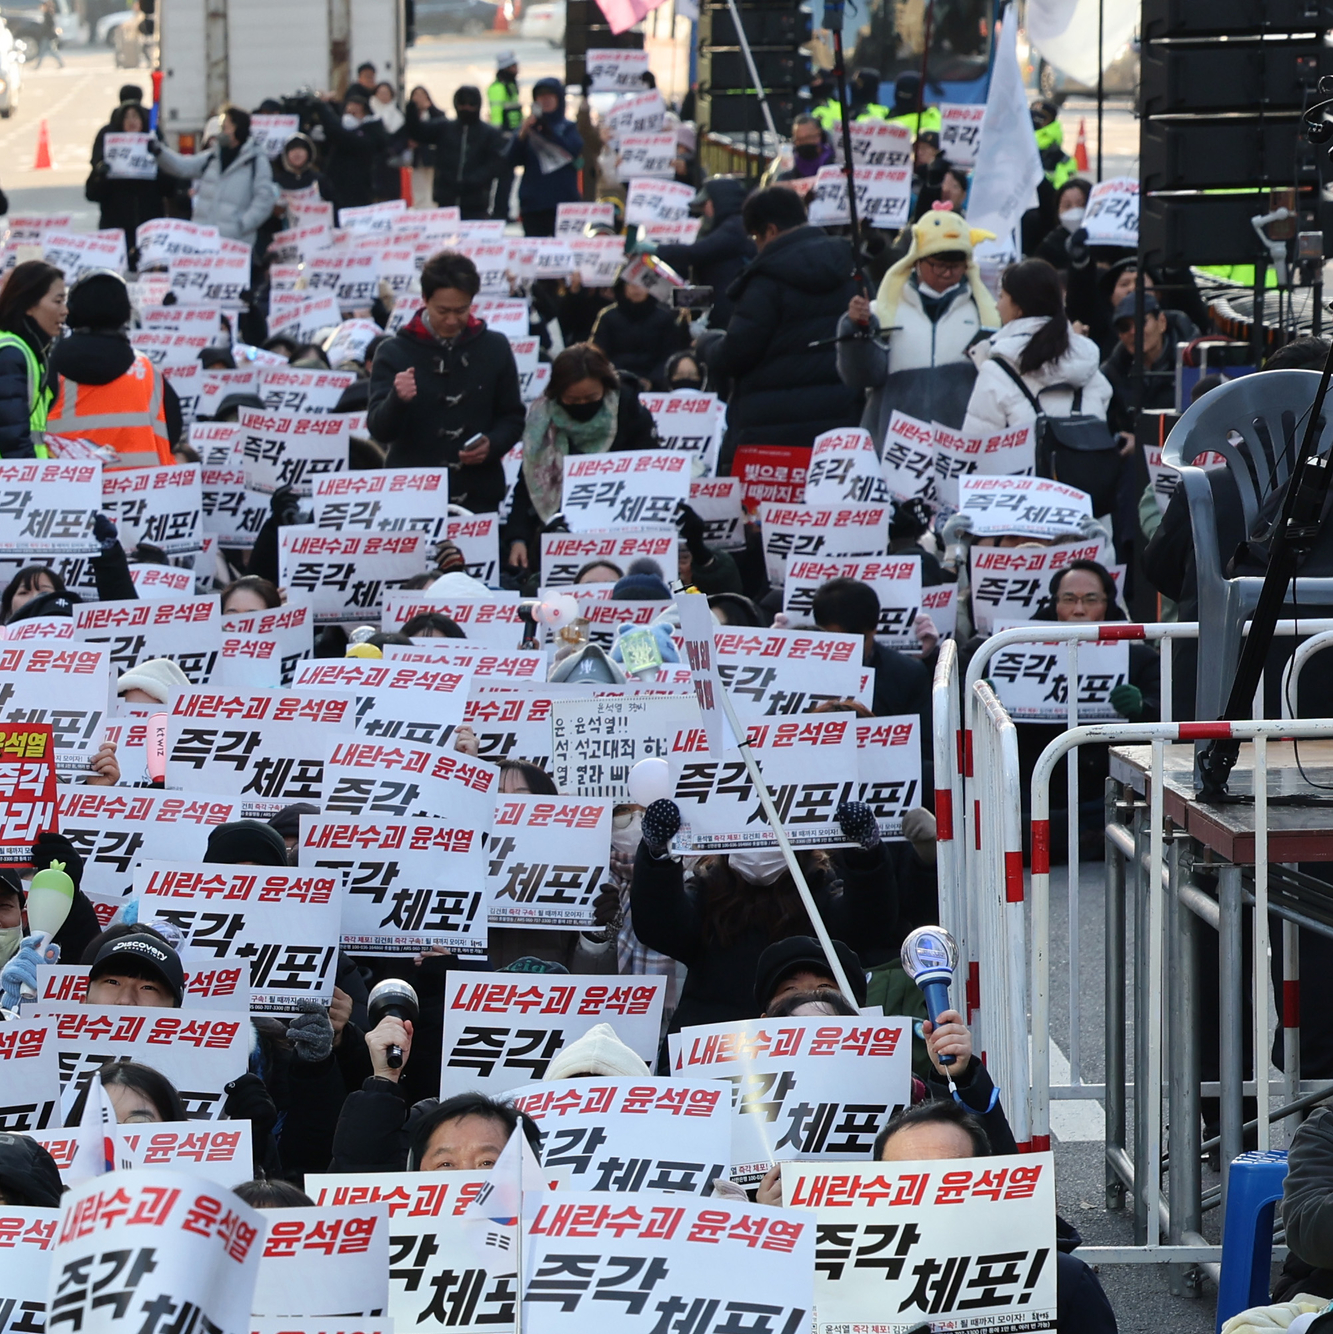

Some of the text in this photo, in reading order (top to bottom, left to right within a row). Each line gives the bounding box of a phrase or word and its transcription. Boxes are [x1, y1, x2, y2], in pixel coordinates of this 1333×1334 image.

[242, 415, 343, 434] 내란수괴 윤석열
[41, 466, 95, 482] 윤석열
[244, 436, 344, 495] 즉각 체포!
[568, 456, 685, 477] 내란수괴 윤석열
[744, 464, 789, 482] 빛으로
[566, 481, 625, 509] 즉각
[18, 508, 95, 540] 체포!
[597, 703, 623, 714] 윤석열
[575, 738, 635, 760] 석고대죄
[112, 941, 168, 961] Discovery
[825, 1324, 890, 1334] 윤석열 즉각 체포!
[939, 1314, 1025, 1330] 구속! 될 때까지 모이자!
